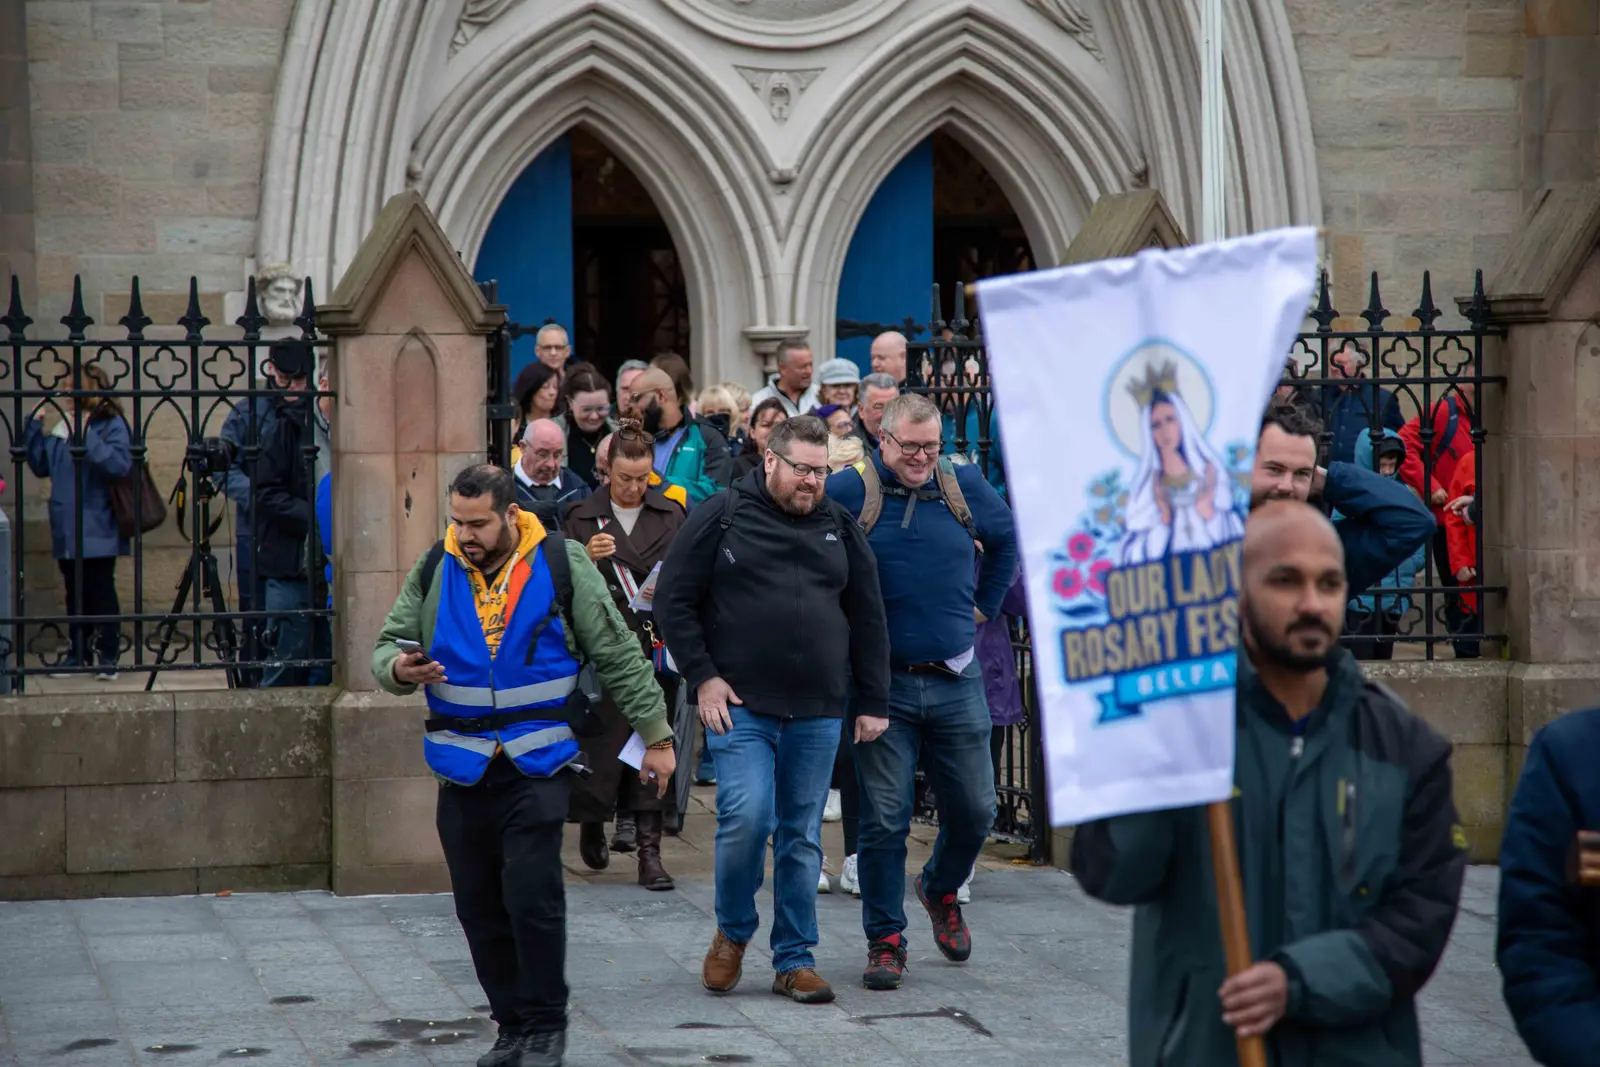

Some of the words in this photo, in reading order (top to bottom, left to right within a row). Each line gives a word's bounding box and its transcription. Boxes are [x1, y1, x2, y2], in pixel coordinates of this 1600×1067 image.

[1108, 563, 1167, 618] OUR
[1173, 543, 1241, 604] LADY
[1064, 611, 1178, 680] ROSARY
[1186, 598, 1237, 656] FES
[1137, 661, 1229, 696] BELFA
